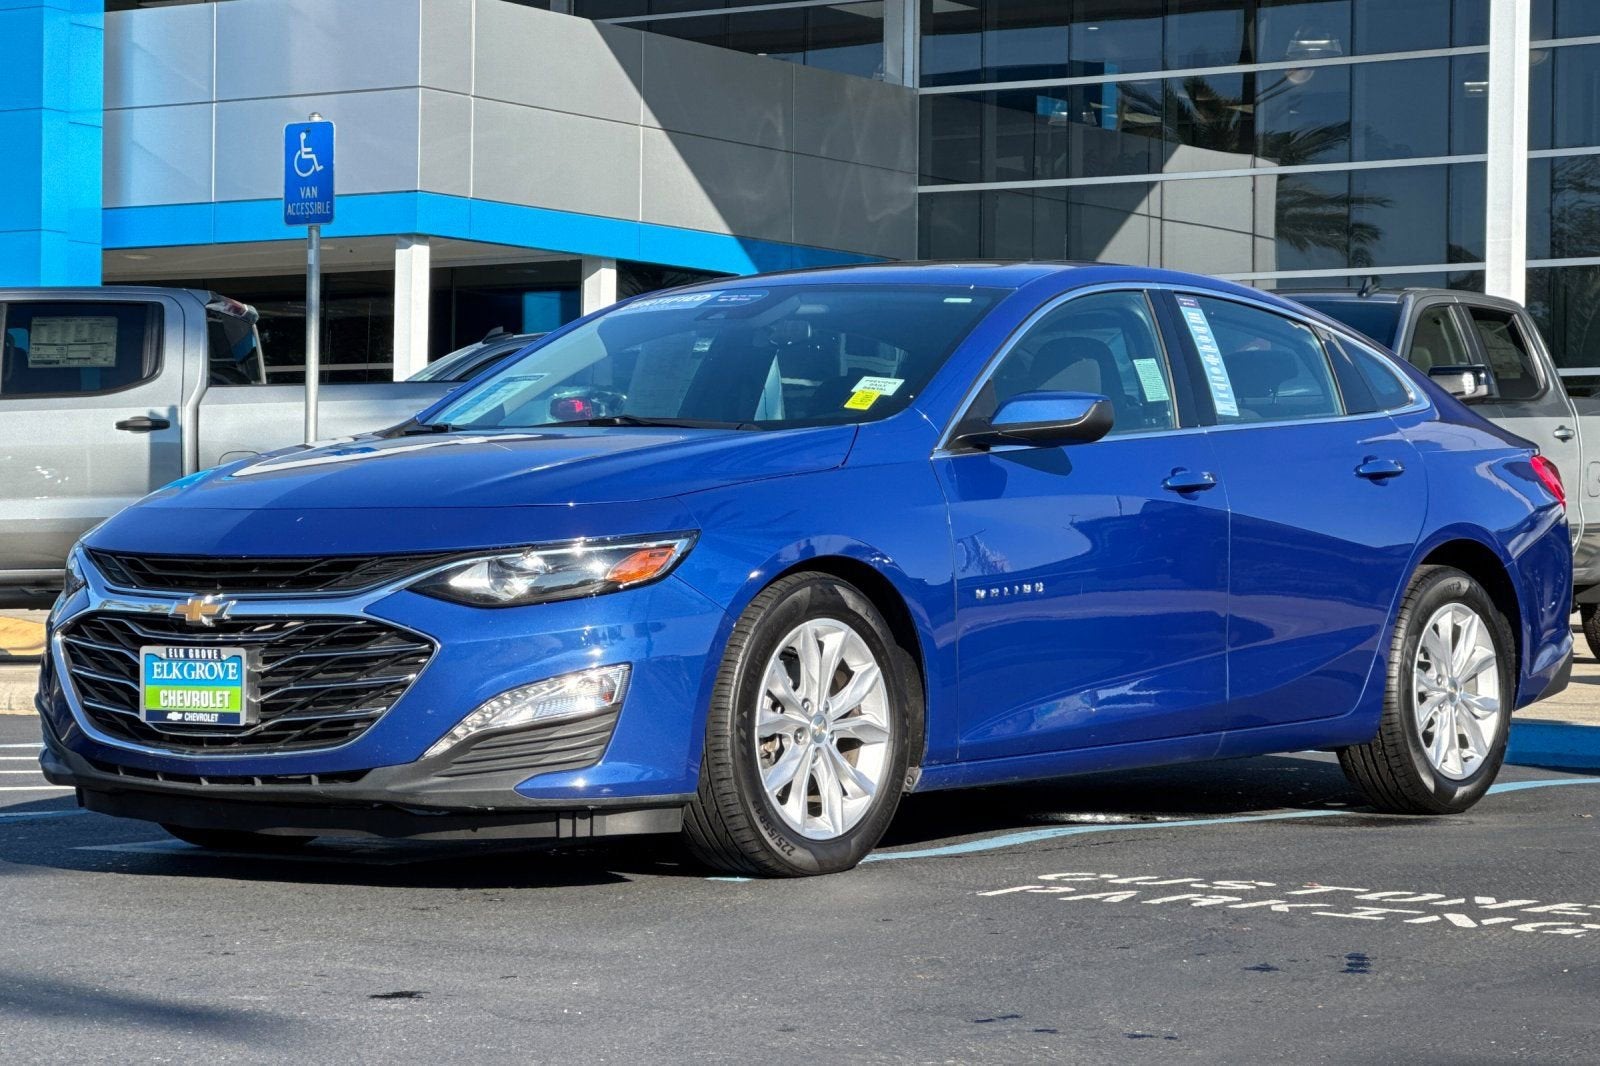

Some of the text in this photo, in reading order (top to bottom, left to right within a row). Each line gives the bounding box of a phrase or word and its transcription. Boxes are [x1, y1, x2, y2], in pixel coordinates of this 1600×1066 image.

[300, 186, 318, 198] VAN
[286, 200, 331, 216] ACCESSIBLE
[975, 582, 1045, 600] MALIBU
[168, 648, 219, 660] ELK GROVE
[152, 662, 239, 680] ELK GROVE
[159, 689, 231, 709] CHEVROLET
[184, 712, 219, 723] CHEVROLET
[1037, 872, 1600, 916] CUSTOME
[975, 885, 1600, 938] PARKING
